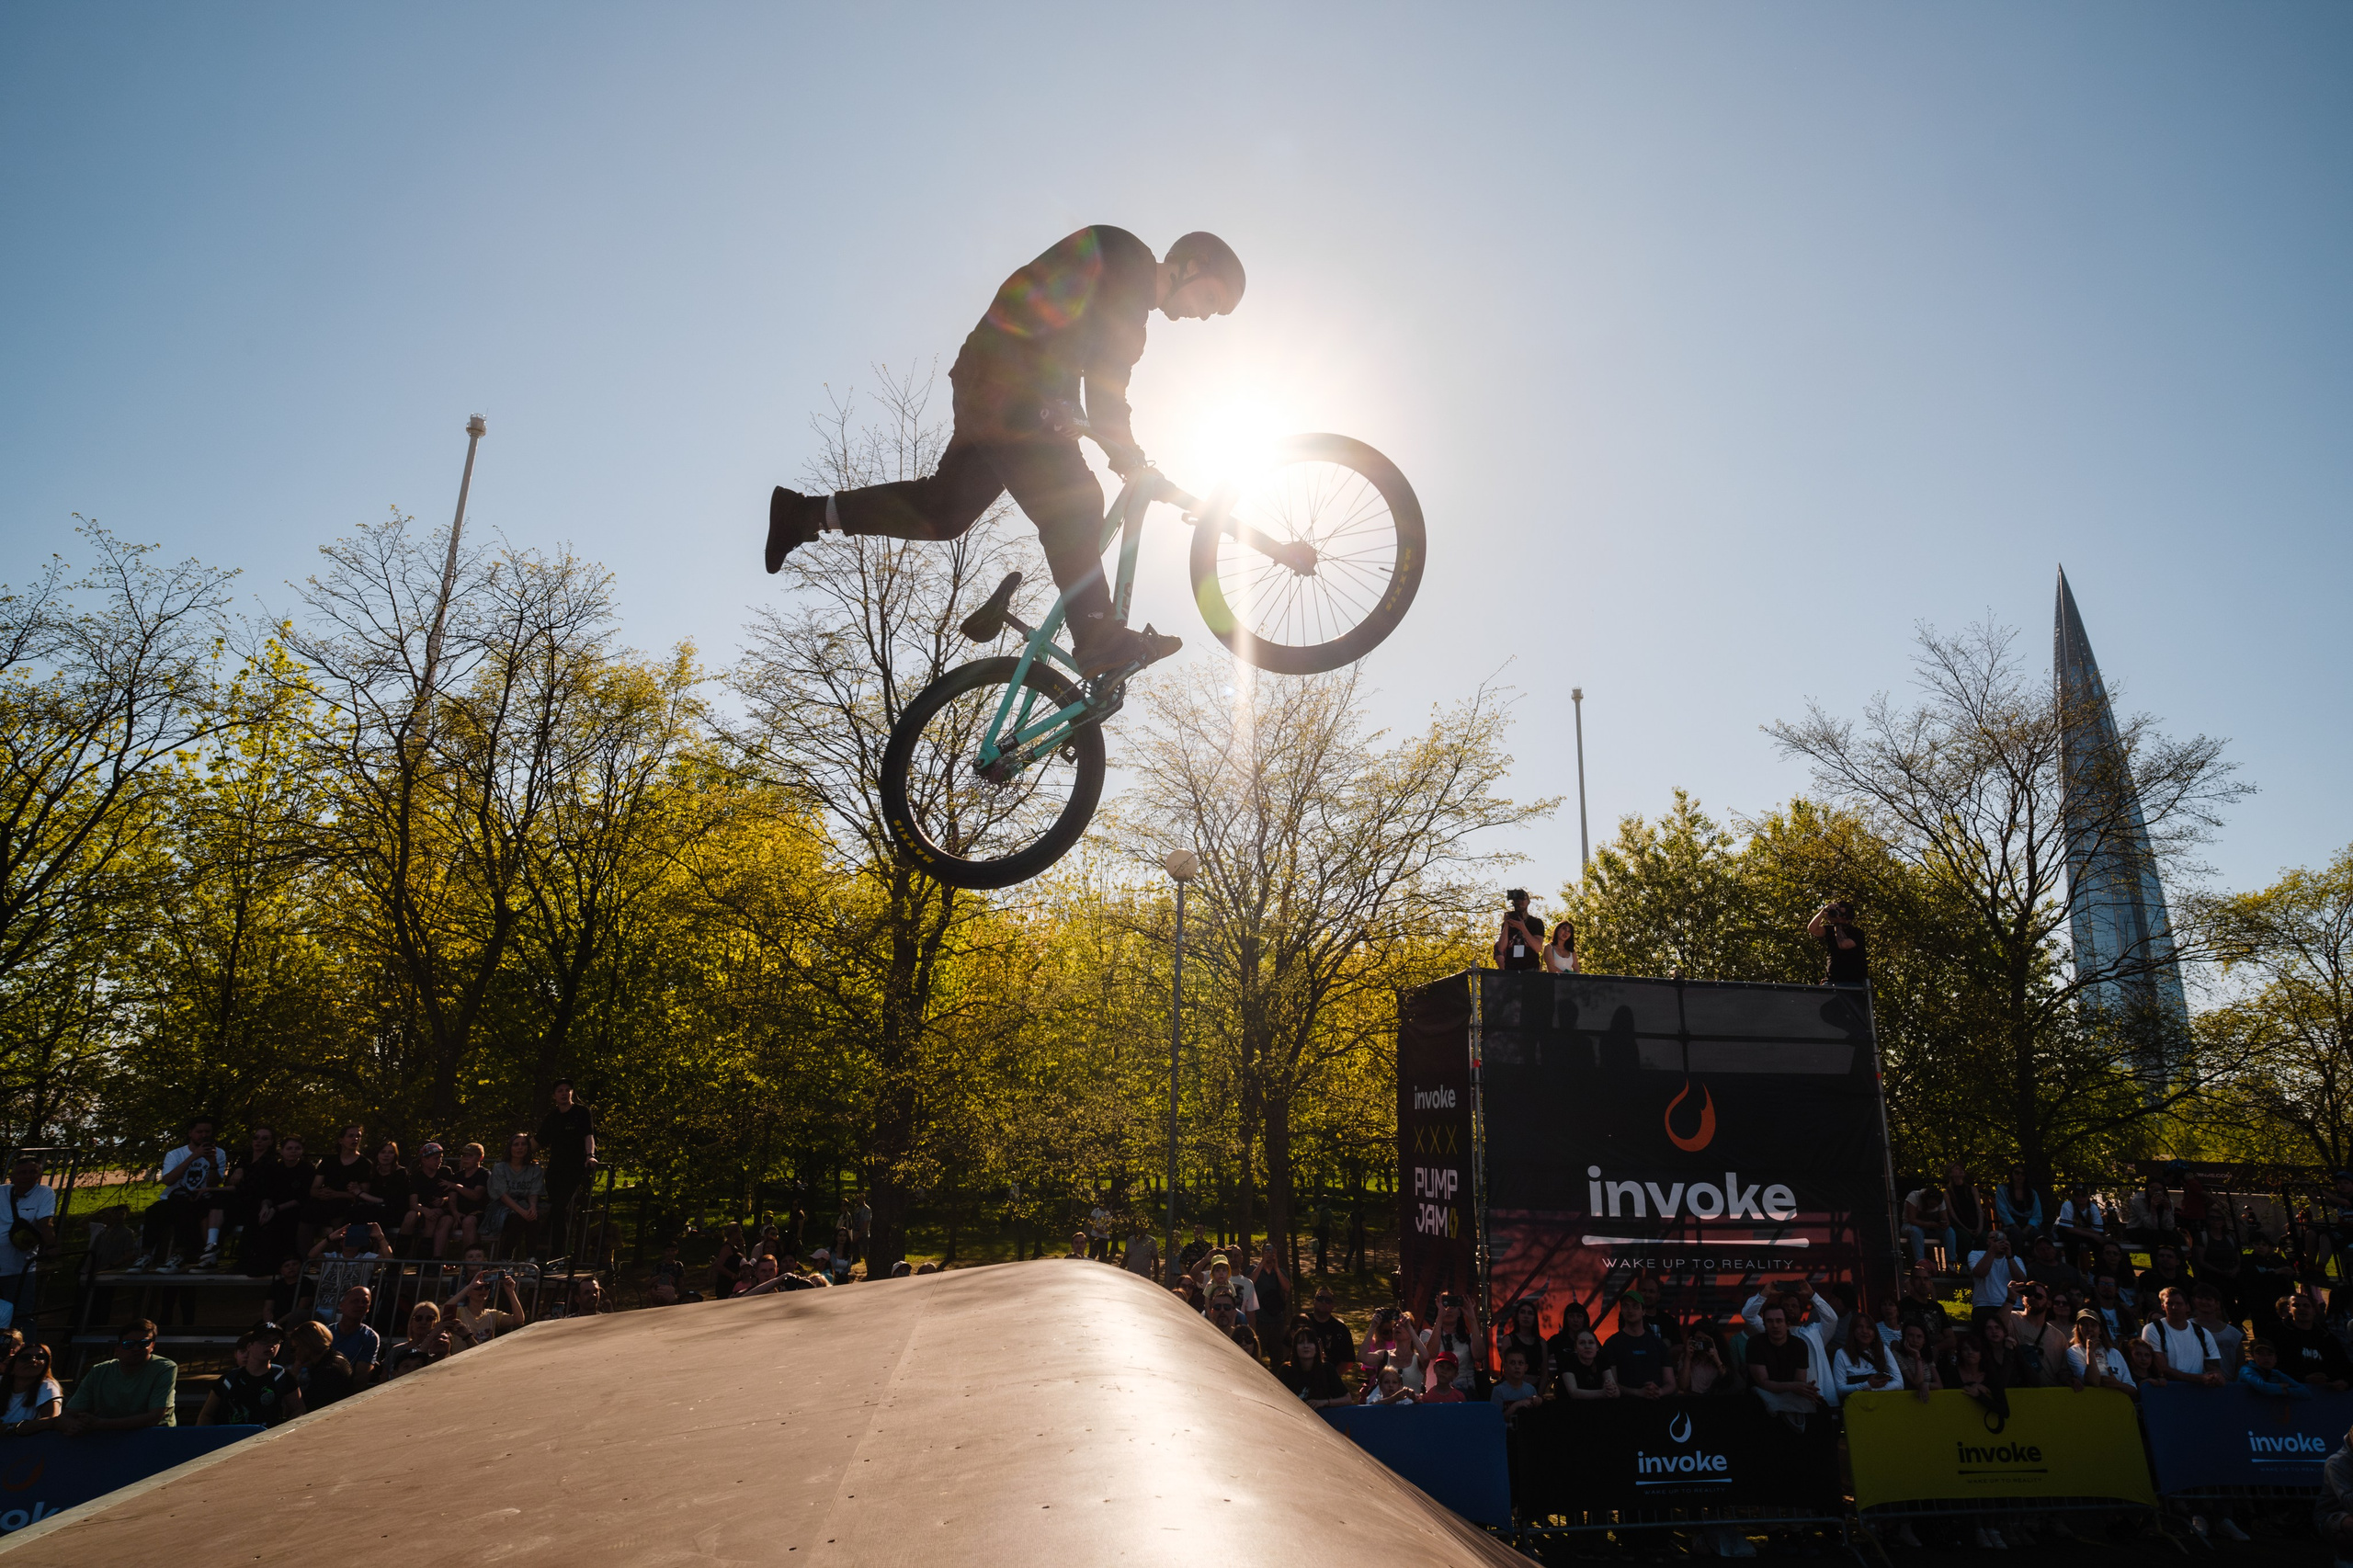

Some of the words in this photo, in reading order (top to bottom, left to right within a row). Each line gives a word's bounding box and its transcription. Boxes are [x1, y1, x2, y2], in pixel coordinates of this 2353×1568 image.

[1385, 548, 1411, 612] MAXXIS
[893, 819, 936, 863] MAXXIS
[1414, 1084, 1456, 1109] invoke
[1415, 1167, 1458, 1200] PUMP
[1587, 1165, 1797, 1221] invoke
[1415, 1203, 1448, 1238] JAM
[1602, 1258, 1655, 1268] WAKE
[1663, 1259, 1685, 1268] UP
[1692, 1259, 1715, 1268] TO
[1722, 1259, 1794, 1269] REALITY
[1957, 1441, 2042, 1463] invoke
[2247, 1430, 2326, 1452] invoke
[1637, 1450, 1728, 1473] invoke
[0, 1501, 74, 1531] ok
